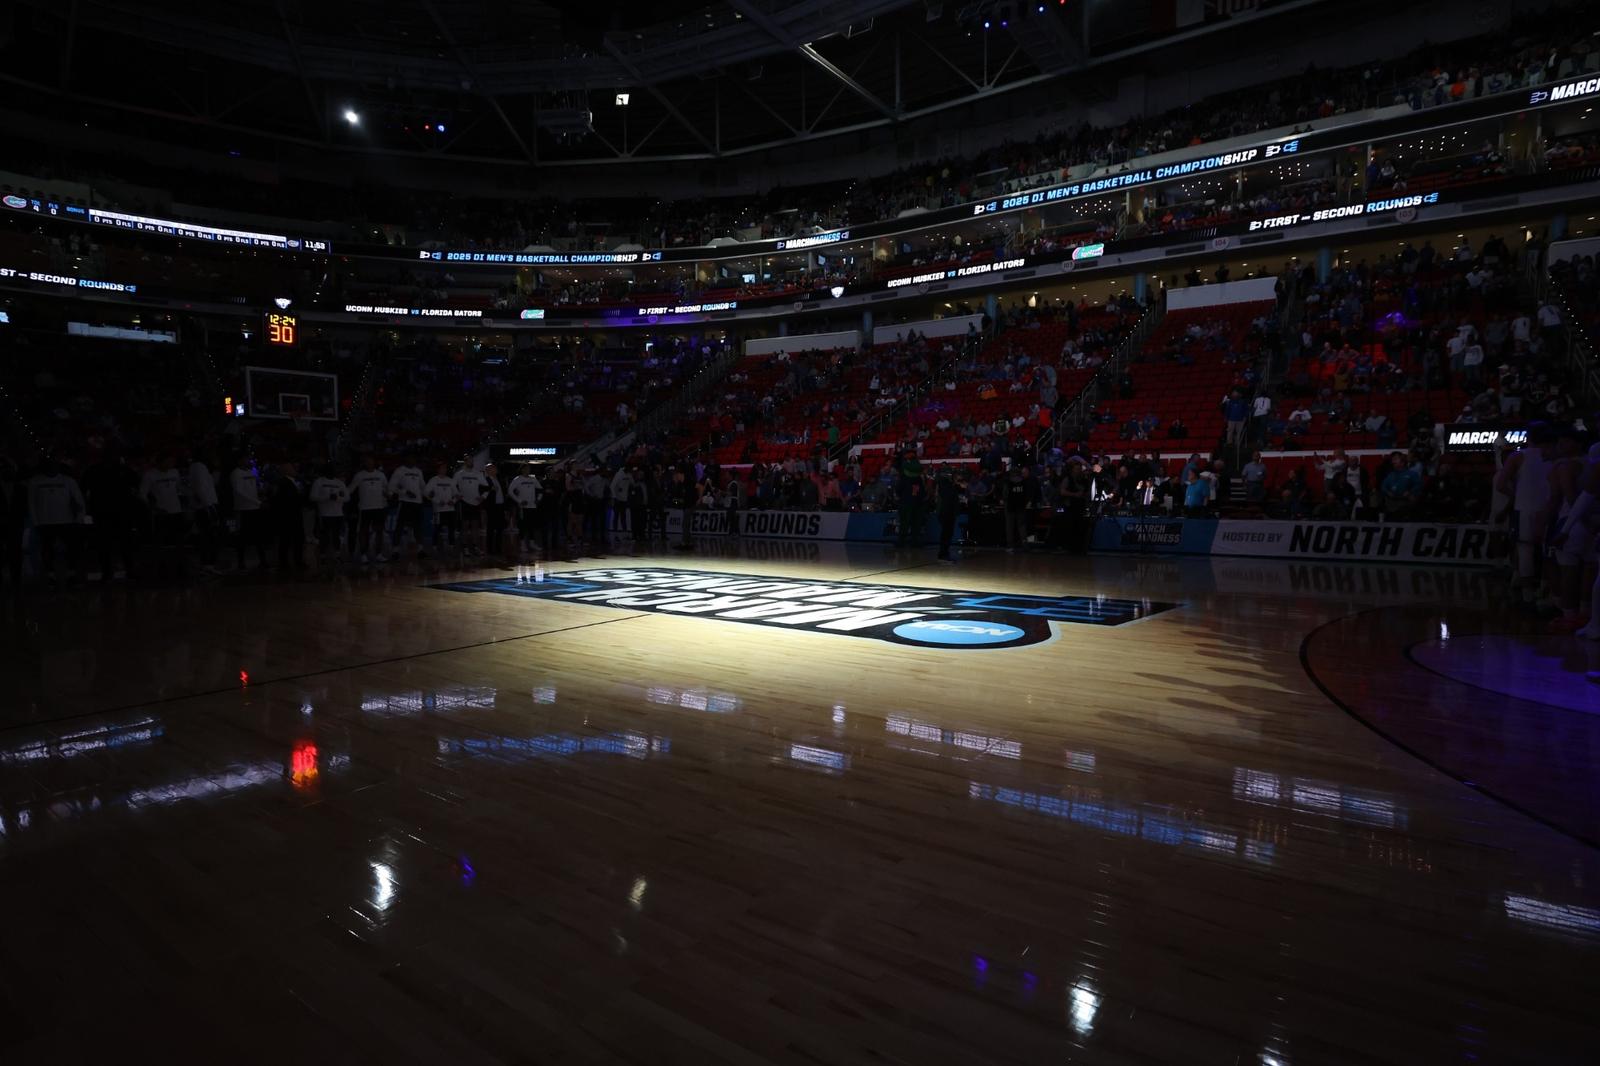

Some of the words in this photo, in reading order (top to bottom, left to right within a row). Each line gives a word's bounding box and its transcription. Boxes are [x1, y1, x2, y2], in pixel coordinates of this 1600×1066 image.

[1002, 198, 1030, 210] 2025
[1032, 194, 1045, 204] DI
[1046, 186, 1079, 201] MEN'S
[1082, 170, 1153, 193] BASKETBALL
[1155, 149, 1258, 179] CHAMPIONSHIP
[1263, 214, 1300, 229] FIRST
[1312, 204, 1364, 222] SECOND
[1366, 195, 1422, 213] ROUNDS
[447, 253, 471, 261] 2025
[473, 253, 484, 261] DI
[486, 254, 514, 262] MEN'S
[515, 254, 569, 263] BASKETBALL
[570, 253, 638, 263] CHAMPIONSHIP
[30, 272, 77, 286] SECOND
[79, 278, 124, 292] ROUNDS
[887, 277, 912, 288] UCONN
[912, 271, 945, 285] HUSKIES
[957, 264, 992, 276] FLORIDA
[992, 258, 1026, 272] GATORS
[345, 305, 373, 314] UCONN
[374, 306, 408, 315] HUSKIES
[421, 309, 453, 317] FLORIDA
[454, 310, 483, 318] GATORS
[646, 307, 668, 315] FIRST
[675, 305, 701, 314] SECOND
[702, 302, 730, 312] ROUNDS
[269, 314, 296, 326] 12:24
[269, 325, 294, 344] 30
[691, 513, 730, 533] ECON
[745, 512, 821, 536] ROUNDS
[1136, 523, 1166, 534] MARCH
[1137, 533, 1181, 545] MADNESS
[1222, 531, 1265, 543] HOSTED
[1267, 532, 1283, 543] BY
[1289, 525, 1404, 556] NORTH
[1412, 527, 1490, 560] CAR
[555, 569, 942, 609] MADNESS
[555, 586, 927, 631] MARCH
